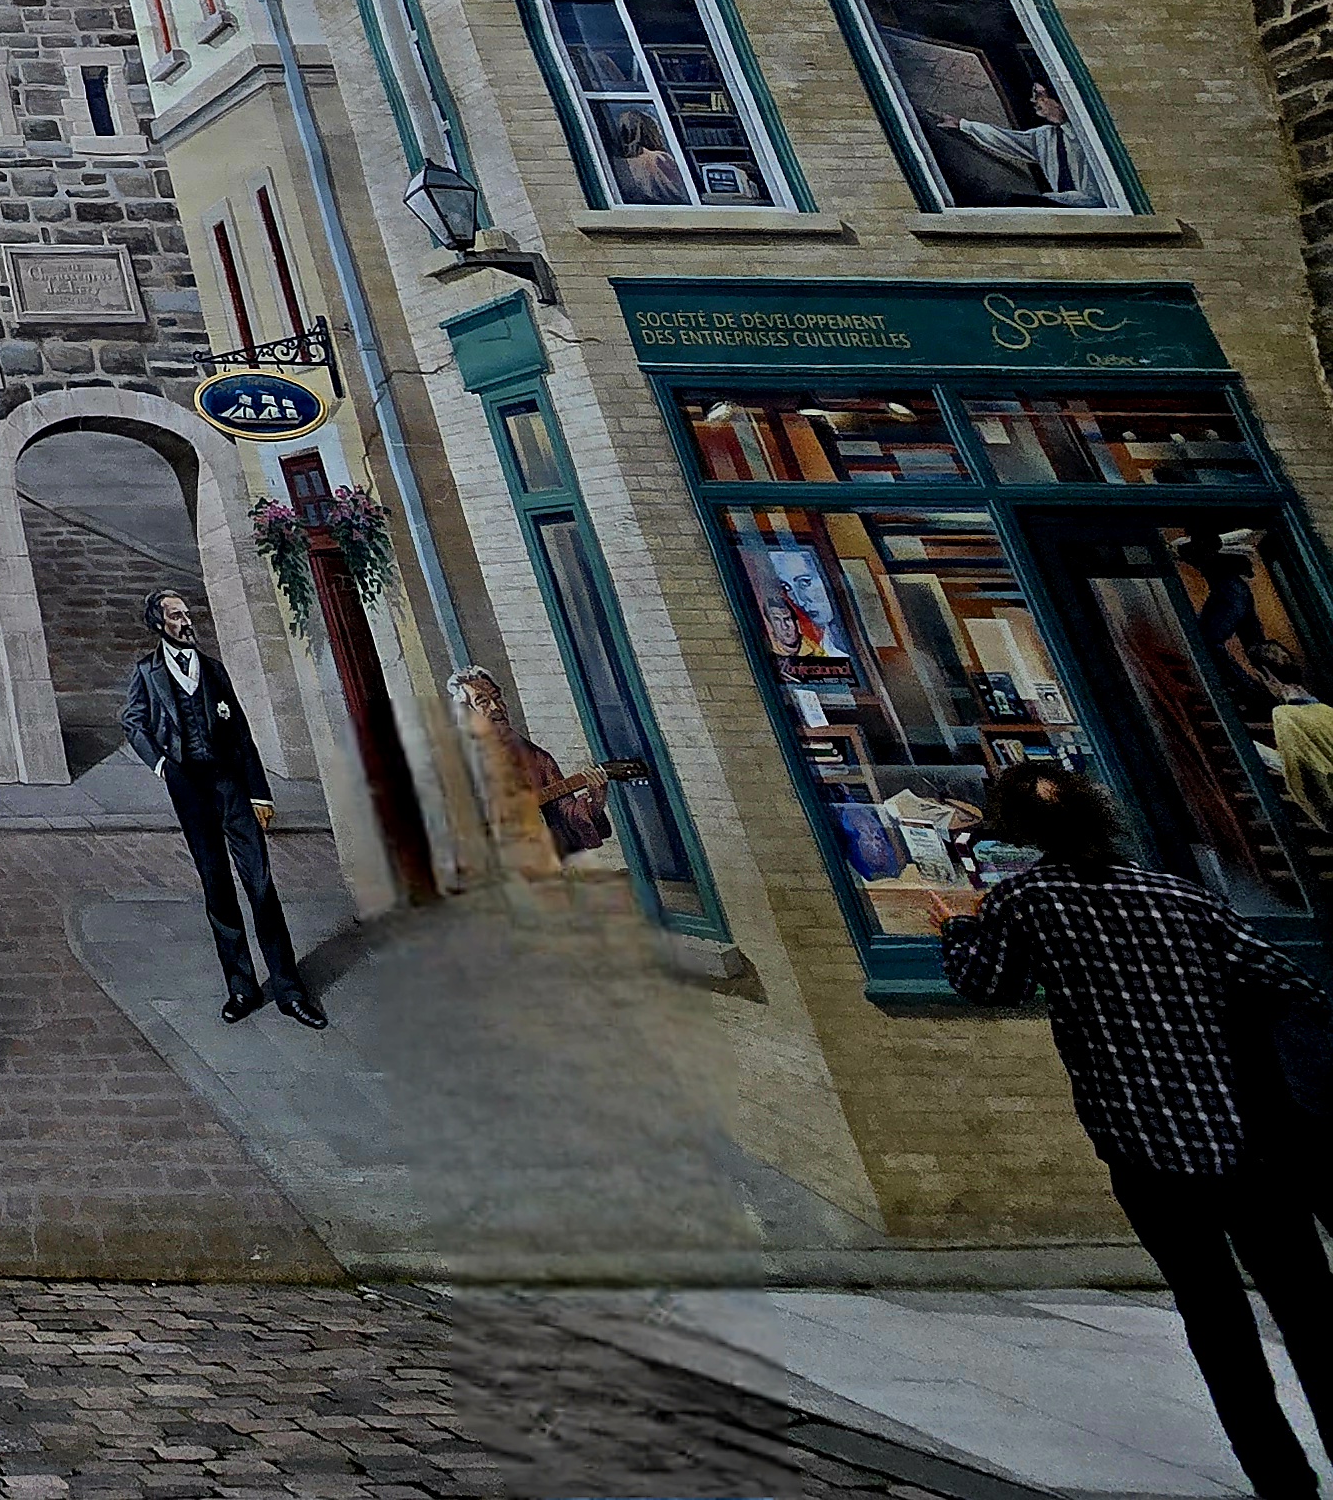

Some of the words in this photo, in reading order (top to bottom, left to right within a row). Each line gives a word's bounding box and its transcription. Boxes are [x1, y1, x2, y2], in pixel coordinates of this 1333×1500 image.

[636, 309, 707, 327] SOCIÉTÉ
[715, 313, 738, 328] DE
[741, 311, 886, 330] DÉVELOPPEMENT
[983, 293, 1128, 349] SODEC
[642, 330, 676, 345] DES
[679, 330, 789, 347] ENTREPRISES
[793, 331, 911, 349] CULTURELLES
